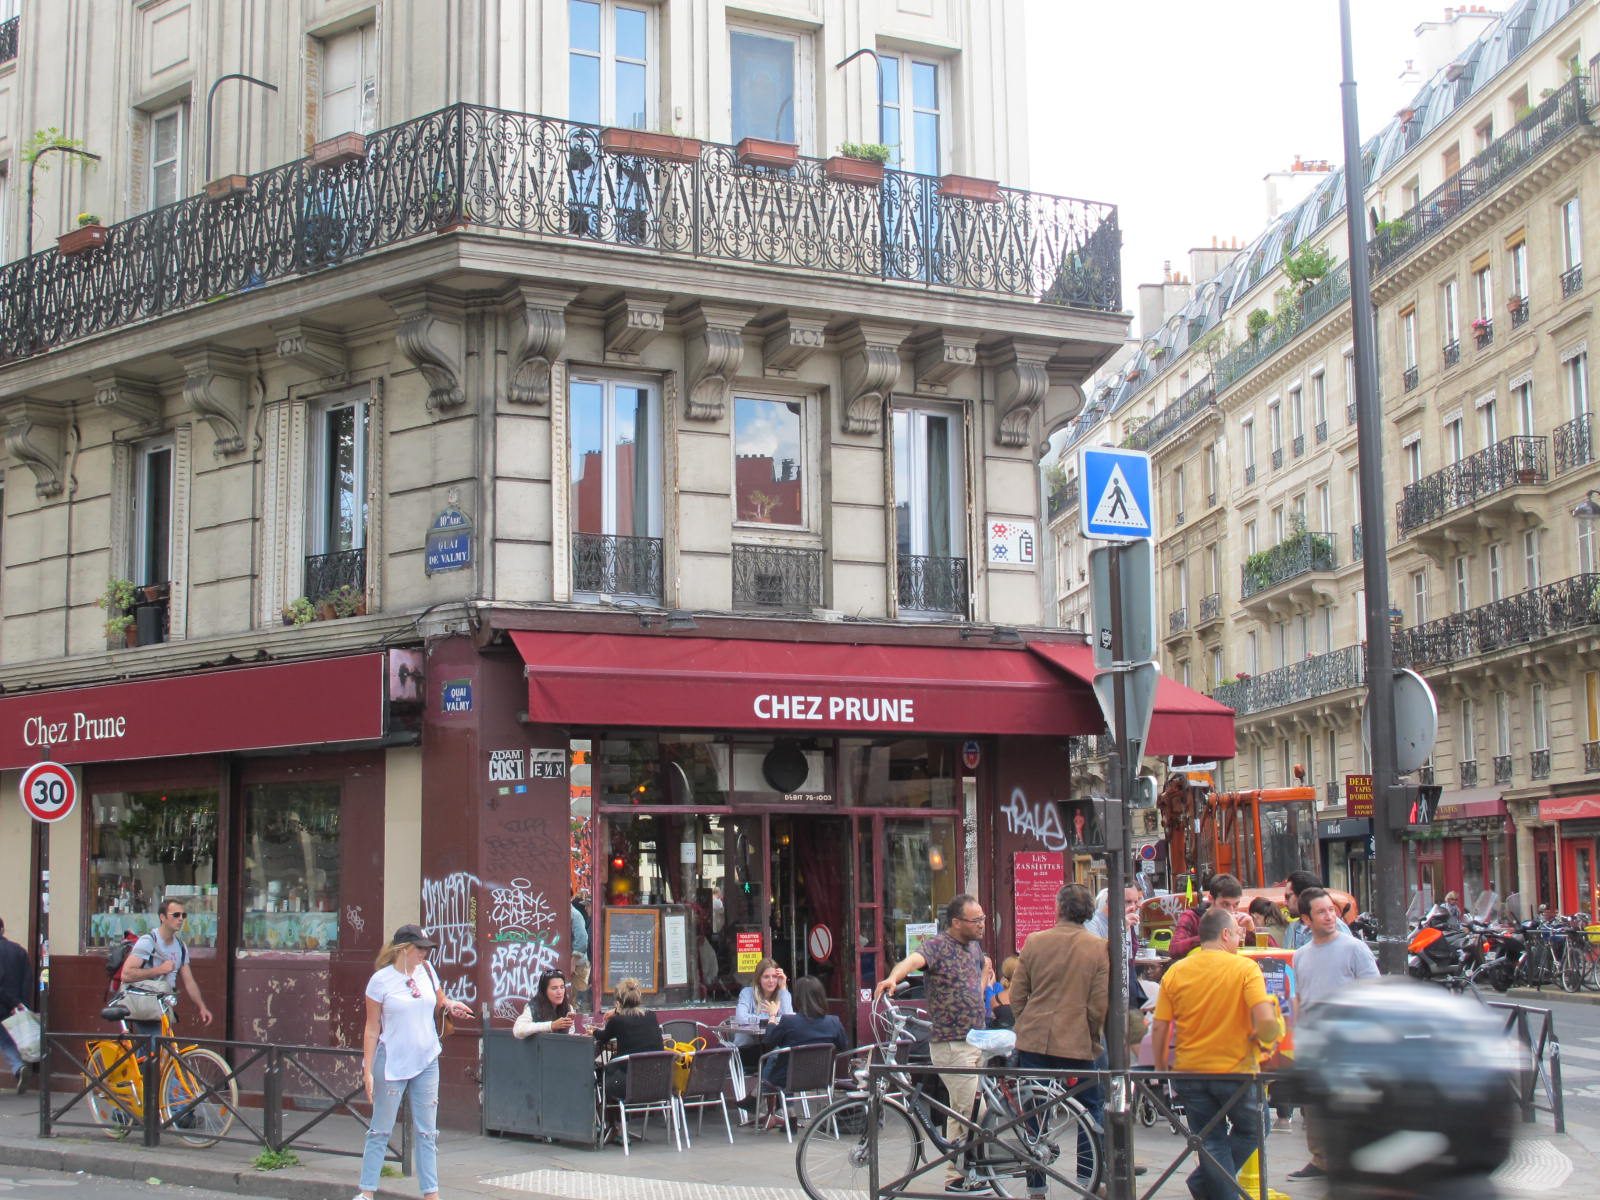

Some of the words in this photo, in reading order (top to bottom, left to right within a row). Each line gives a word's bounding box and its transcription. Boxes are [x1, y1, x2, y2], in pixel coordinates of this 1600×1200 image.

[438, 539, 458, 551] QUAI
[429, 554, 439, 565] DE
[441, 551, 467, 564] VALMY
[451, 687, 467, 698] QUAI
[446, 701, 470, 711] VALMY
[753, 694, 823, 720] CHEZ
[829, 696, 914, 722] PRUNE
[23, 716, 68, 746] Chez
[73, 712, 126, 741] Prune
[491, 749, 520, 760] ADAM
[489, 759, 524, 781] COST
[1349, 777, 1373, 786] DELT
[33, 780, 65, 804] 30
